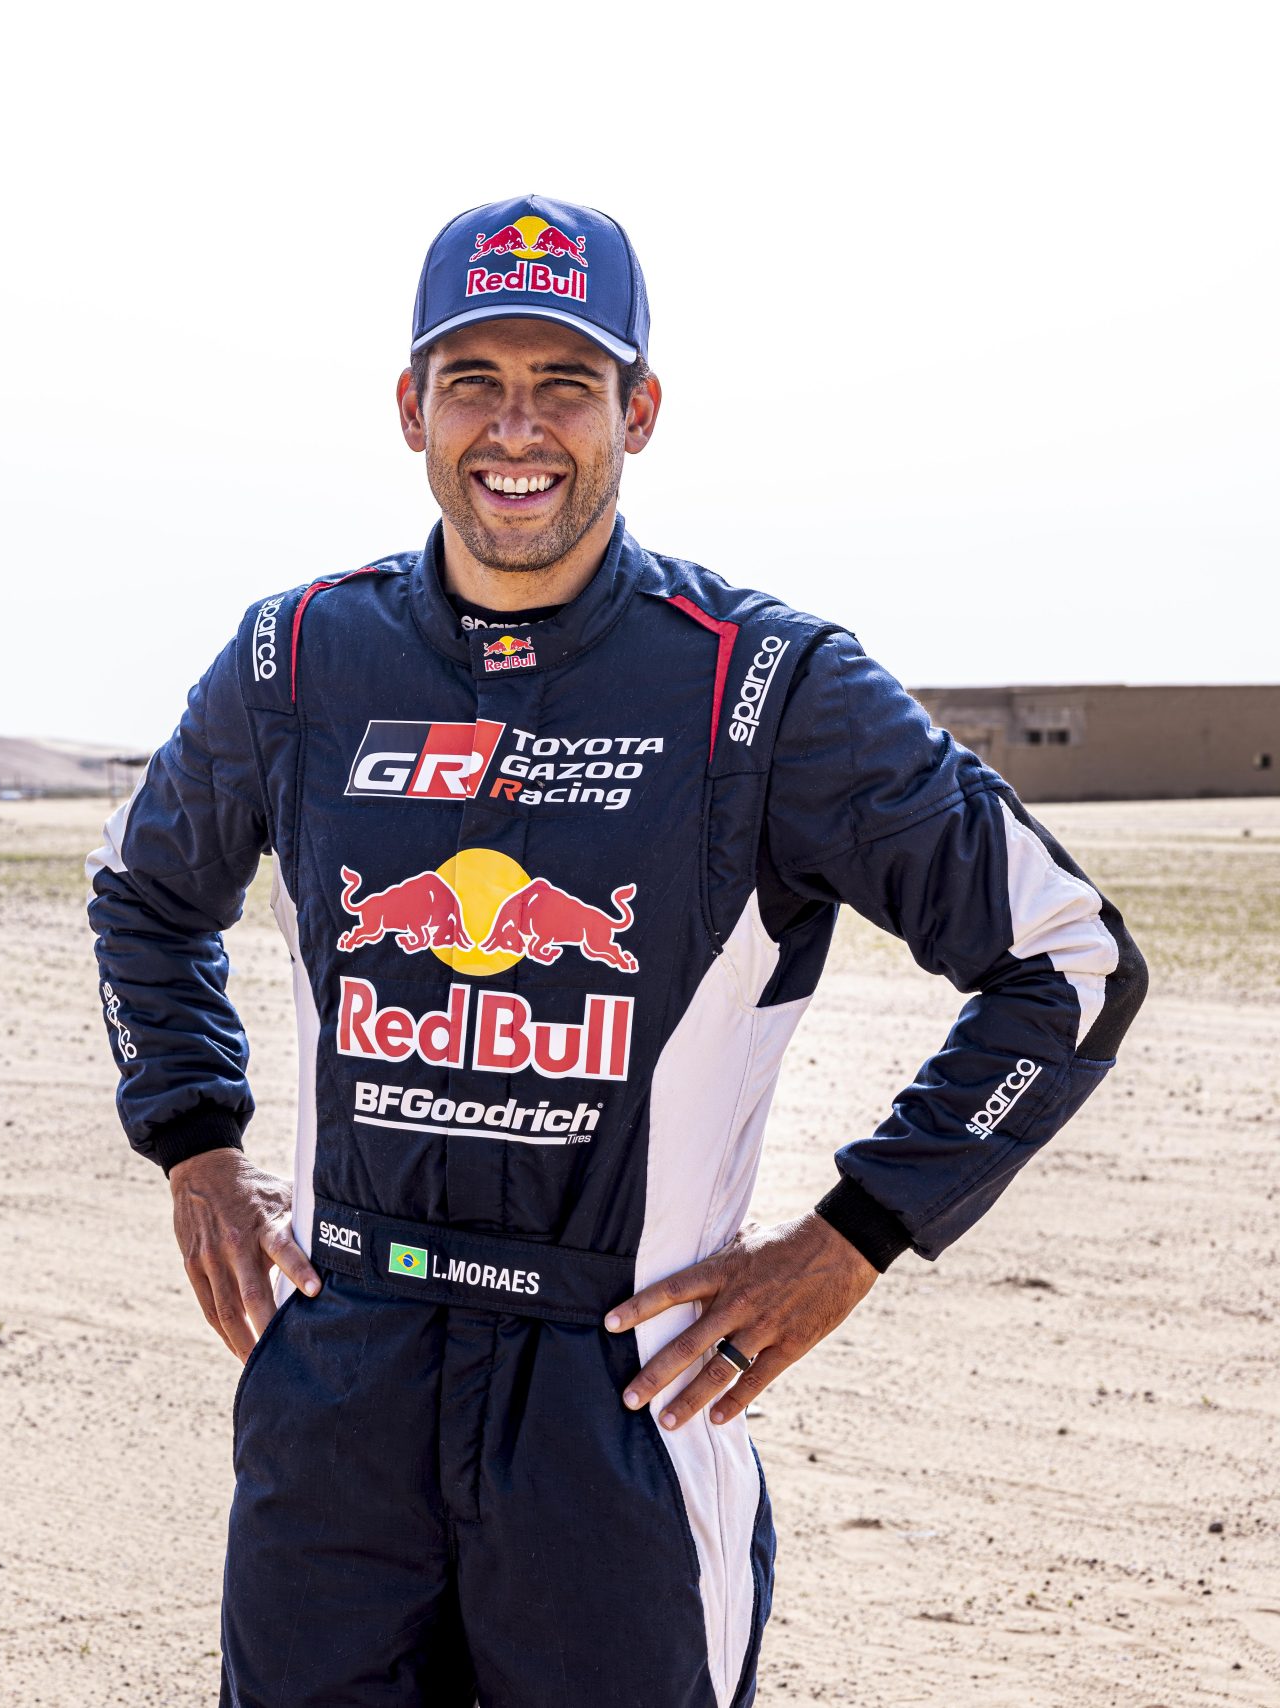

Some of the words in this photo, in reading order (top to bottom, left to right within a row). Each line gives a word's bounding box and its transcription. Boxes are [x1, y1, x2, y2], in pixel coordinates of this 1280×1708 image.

[465, 261, 527, 298] Red
[528, 262, 587, 302] Bull
[485, 656, 510, 672] Red
[511, 652, 537, 668] Bull
[728, 635, 791, 747] sparco
[354, 750, 484, 796] GR
[512, 728, 664, 756] TOYOTA
[500, 755, 644, 781] GAZOO
[489, 777, 632, 810] Racing
[336, 975, 471, 1070] Red
[472, 989, 636, 1082] Bull
[355, 1081, 601, 1133] BFGoodrich
[965, 1058, 1042, 1140] sparco
[567, 1133, 592, 1145] Tires
[319, 1220, 361, 1255] spar
[432, 1255, 541, 1295] L.MORAES
